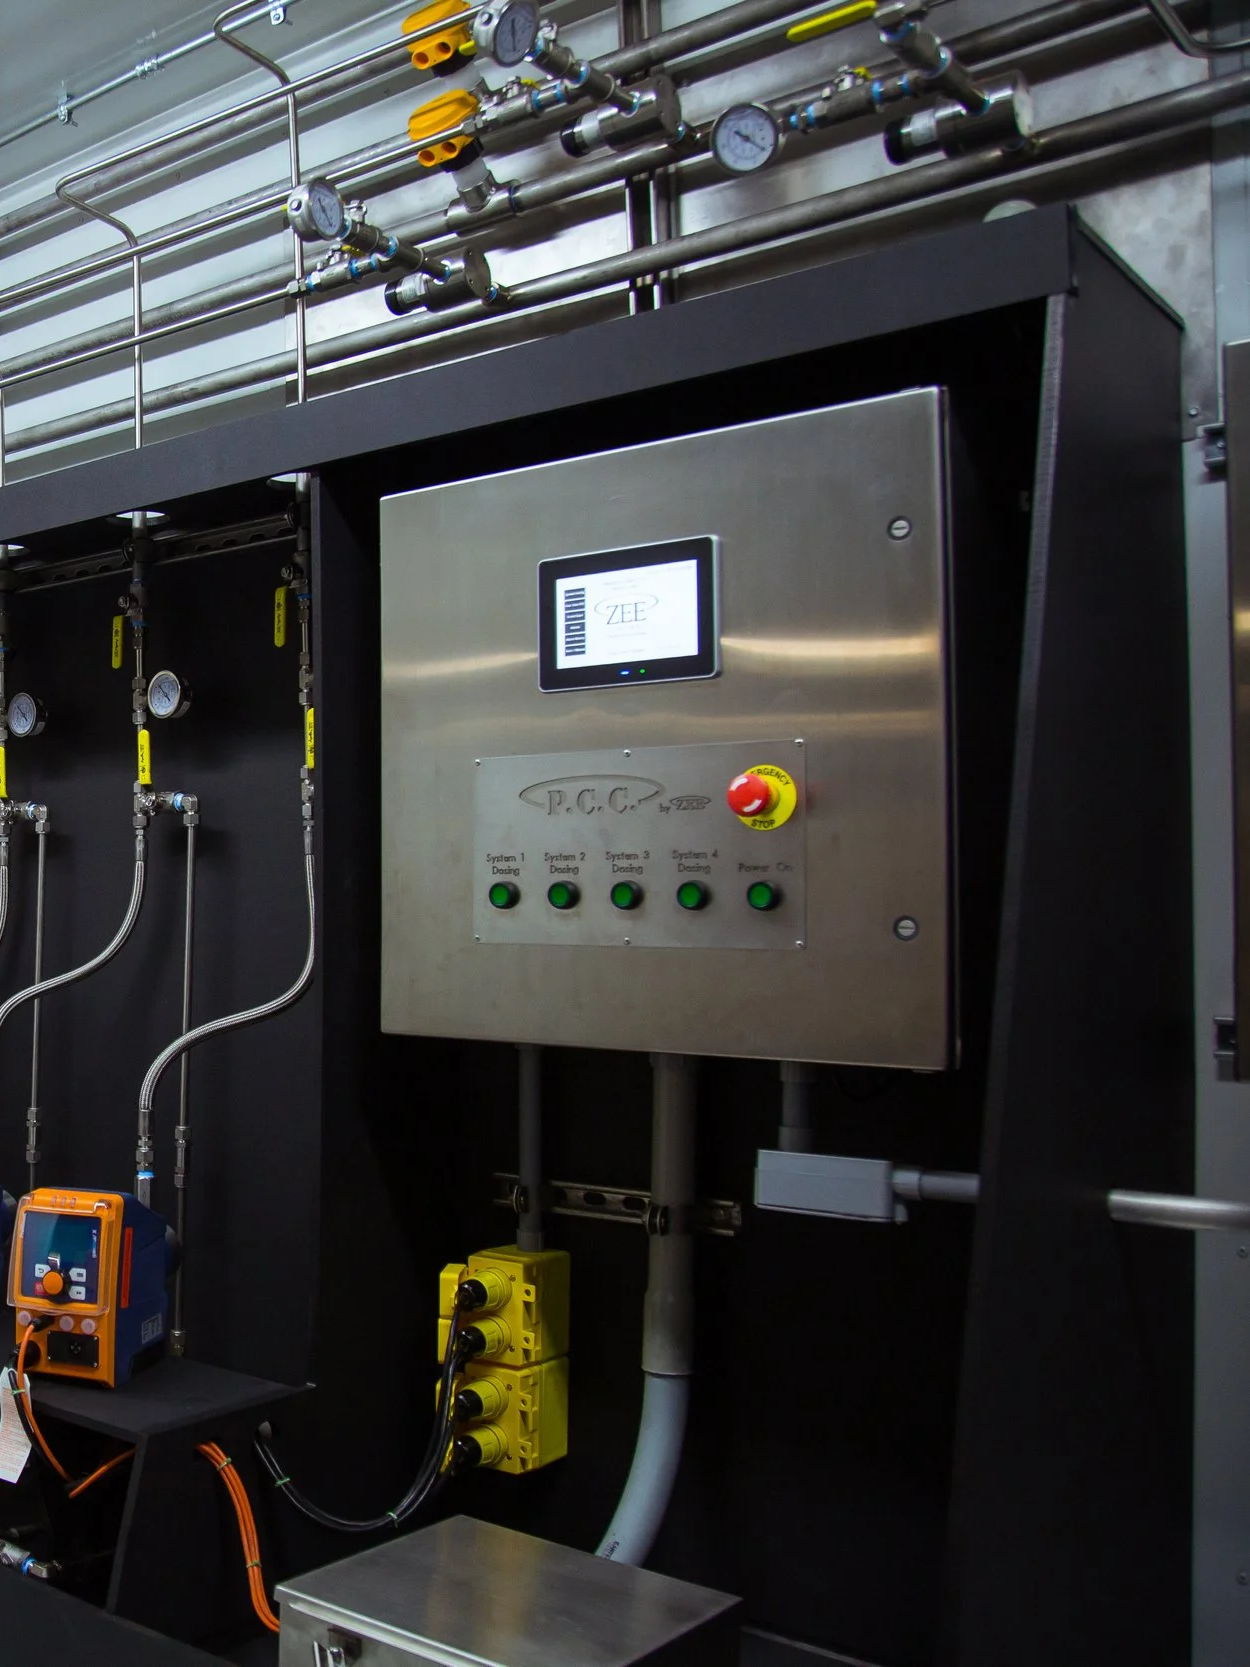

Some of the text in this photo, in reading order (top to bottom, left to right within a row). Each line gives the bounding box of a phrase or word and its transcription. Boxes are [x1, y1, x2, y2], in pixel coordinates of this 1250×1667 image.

[606, 601, 647, 625] ZEE
[658, 803, 670, 815] by
[751, 819, 776, 829] STOP
[486, 853, 517, 864] System
[544, 852, 576, 863] System
[605, 851, 639, 862] System
[672, 850, 708, 861] System
[492, 866, 520, 877] Dosing
[549, 865, 580, 876] Dosing
[611, 864, 644, 875] Dosing
[677, 863, 711, 874] Dosing
[738, 862, 793, 872] Power On
